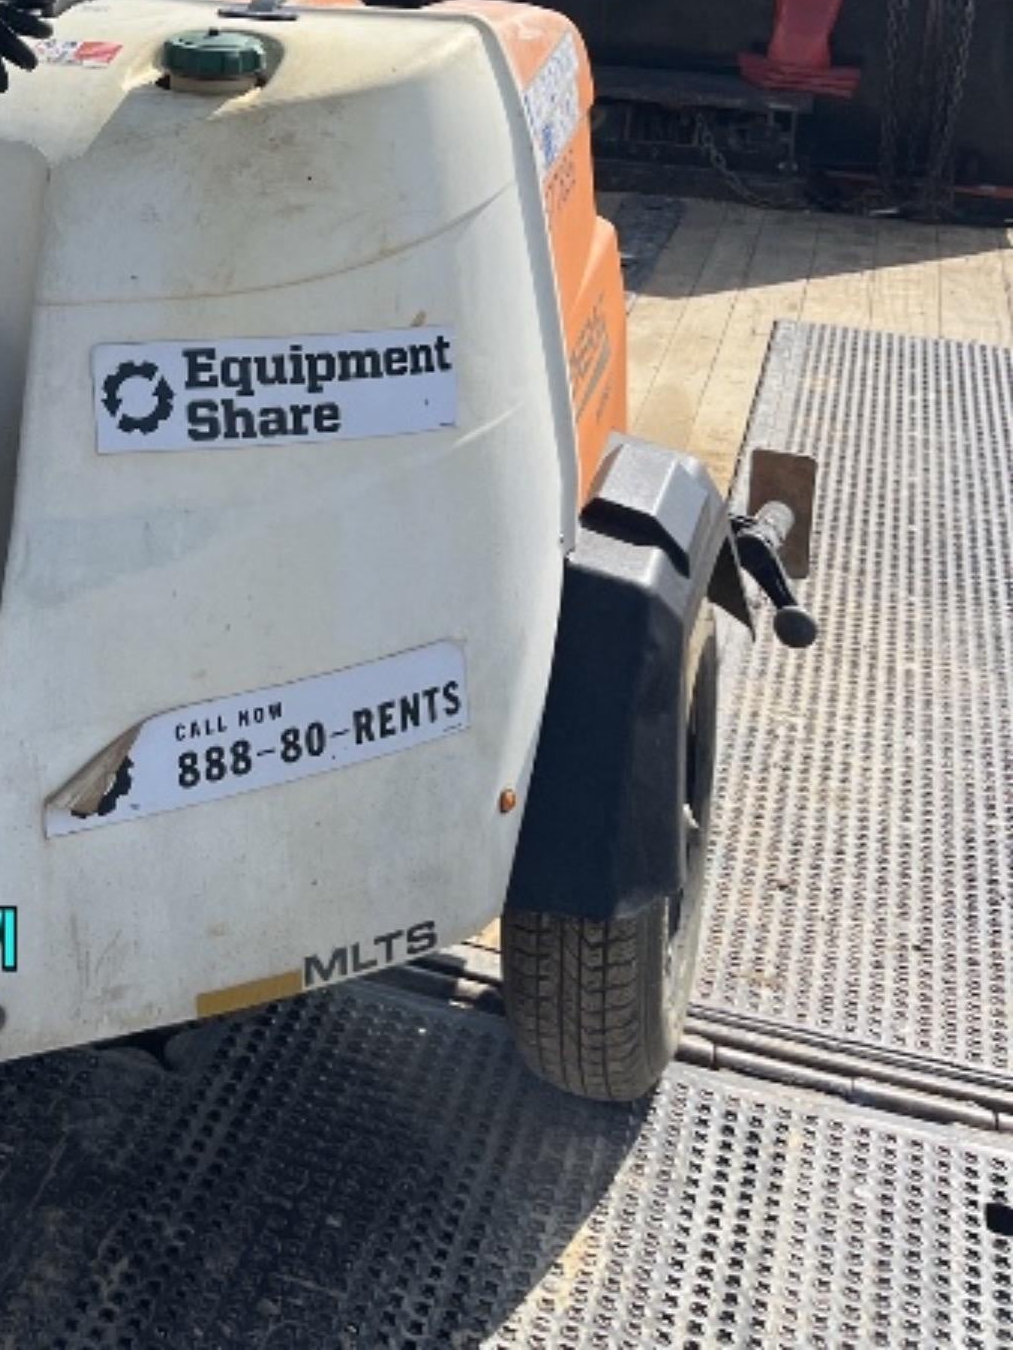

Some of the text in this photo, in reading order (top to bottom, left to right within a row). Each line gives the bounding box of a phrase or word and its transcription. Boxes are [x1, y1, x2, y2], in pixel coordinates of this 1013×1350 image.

[183, 335, 453, 397] Equipment
[187, 399, 341, 441] Share
[175, 702, 283, 742] CALL NOW
[178, 680, 462, 789] 888-80-RENTS
[304, 920, 438, 987] MLTS
